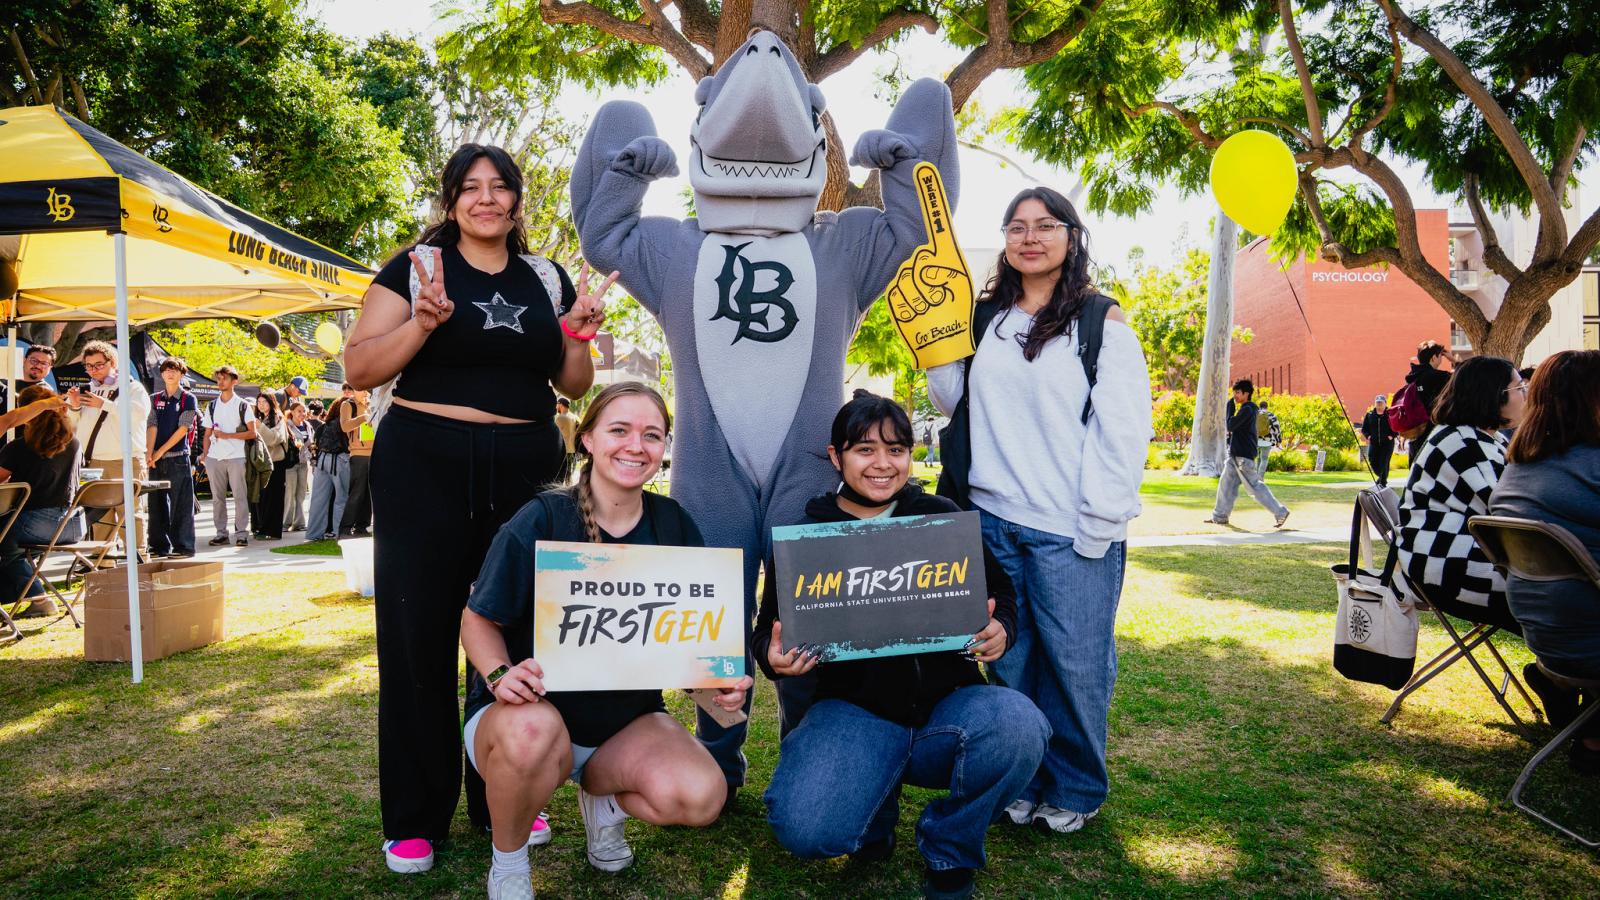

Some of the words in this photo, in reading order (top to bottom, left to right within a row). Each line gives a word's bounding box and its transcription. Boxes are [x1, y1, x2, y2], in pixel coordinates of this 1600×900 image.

[46, 187, 75, 223] LB
[228, 230, 266, 261] LONG
[269, 247, 307, 275] BEACH
[1312, 271, 1388, 282] PSYCHOLOGY
[708, 241, 800, 346] LB
[916, 331, 927, 345] Go
[570, 580, 646, 597] PROUD
[654, 582, 681, 597] TO
[689, 584, 715, 598] BE
[795, 574, 805, 599] I
[806, 571, 843, 600] AM
[795, 601, 844, 611] CALIFORNIA
[846, 598, 870, 607] STATE
[873, 594, 919, 604] UNIVERSITY
[922, 591, 942, 600] LONG
[945, 589, 970, 598] BEACH
